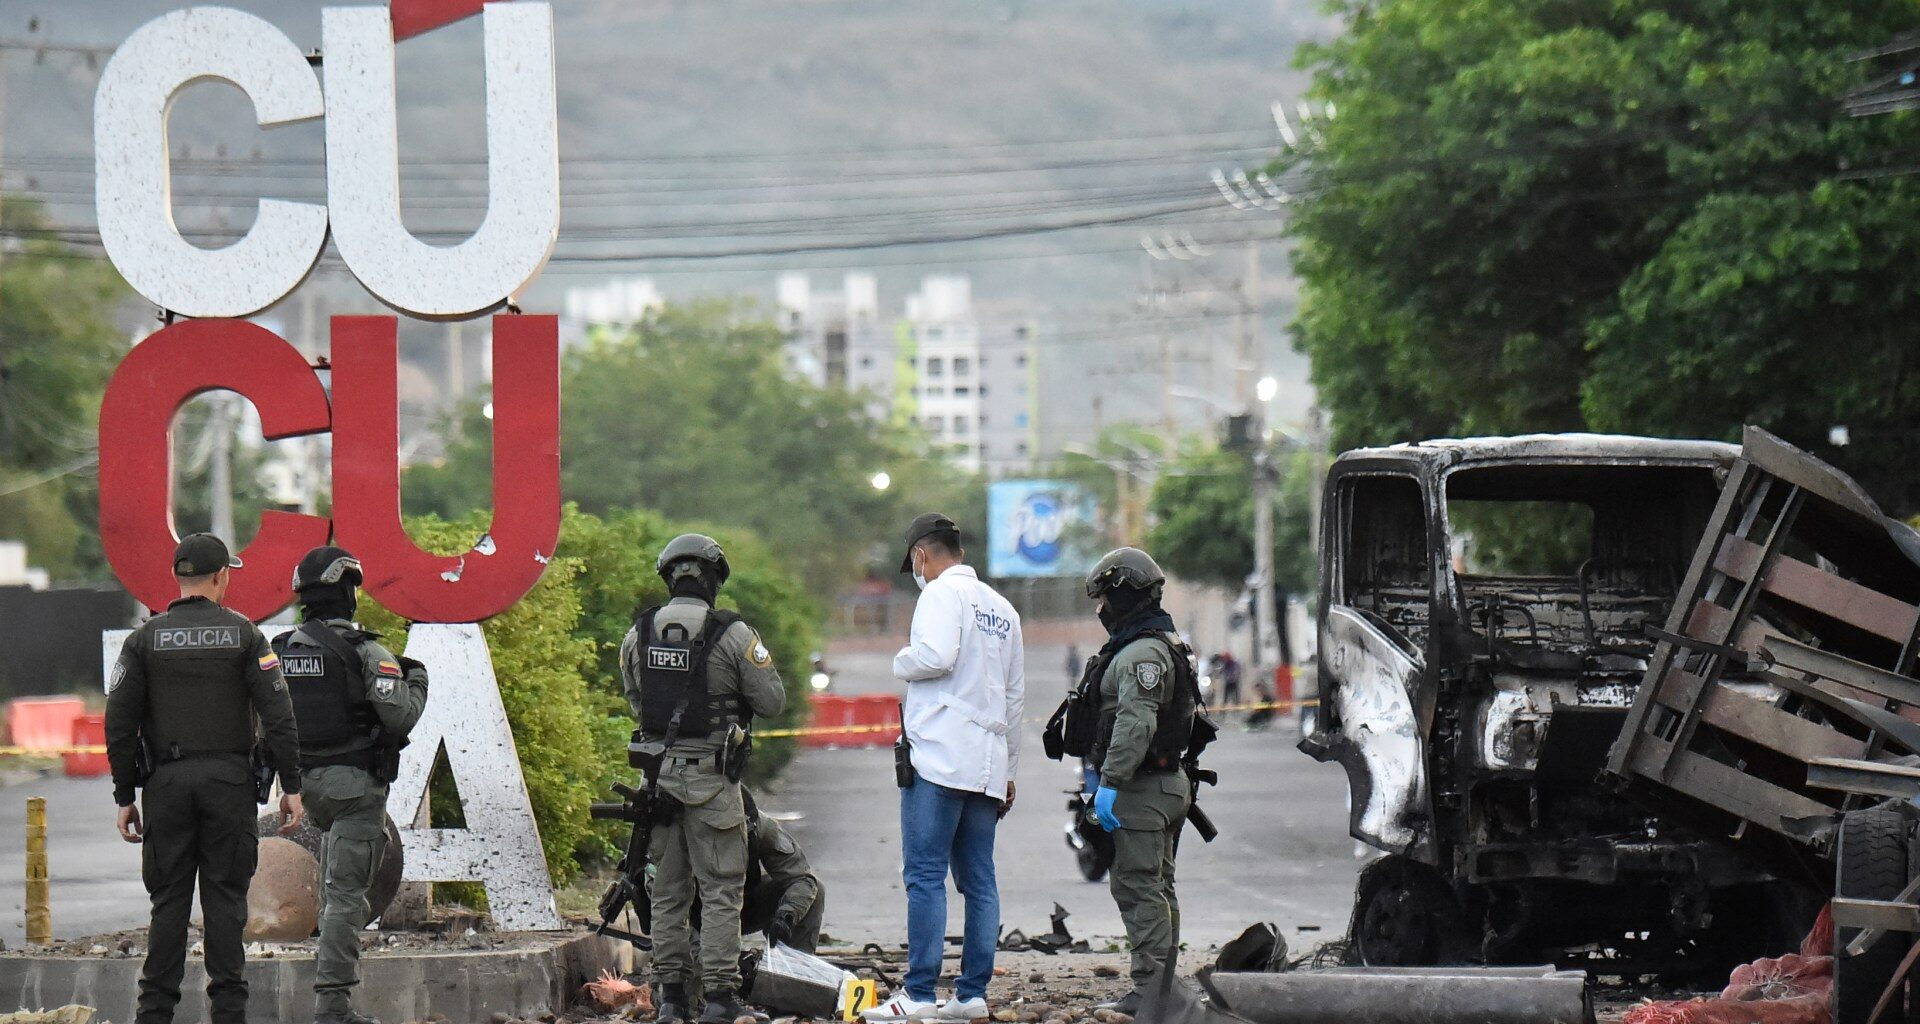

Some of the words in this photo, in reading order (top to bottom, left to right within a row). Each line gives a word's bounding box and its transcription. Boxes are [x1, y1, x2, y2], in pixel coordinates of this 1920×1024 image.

[160, 629, 234, 647] POLICIA
[651, 650, 685, 668] TEPEX
[852, 985, 865, 1017] 2
